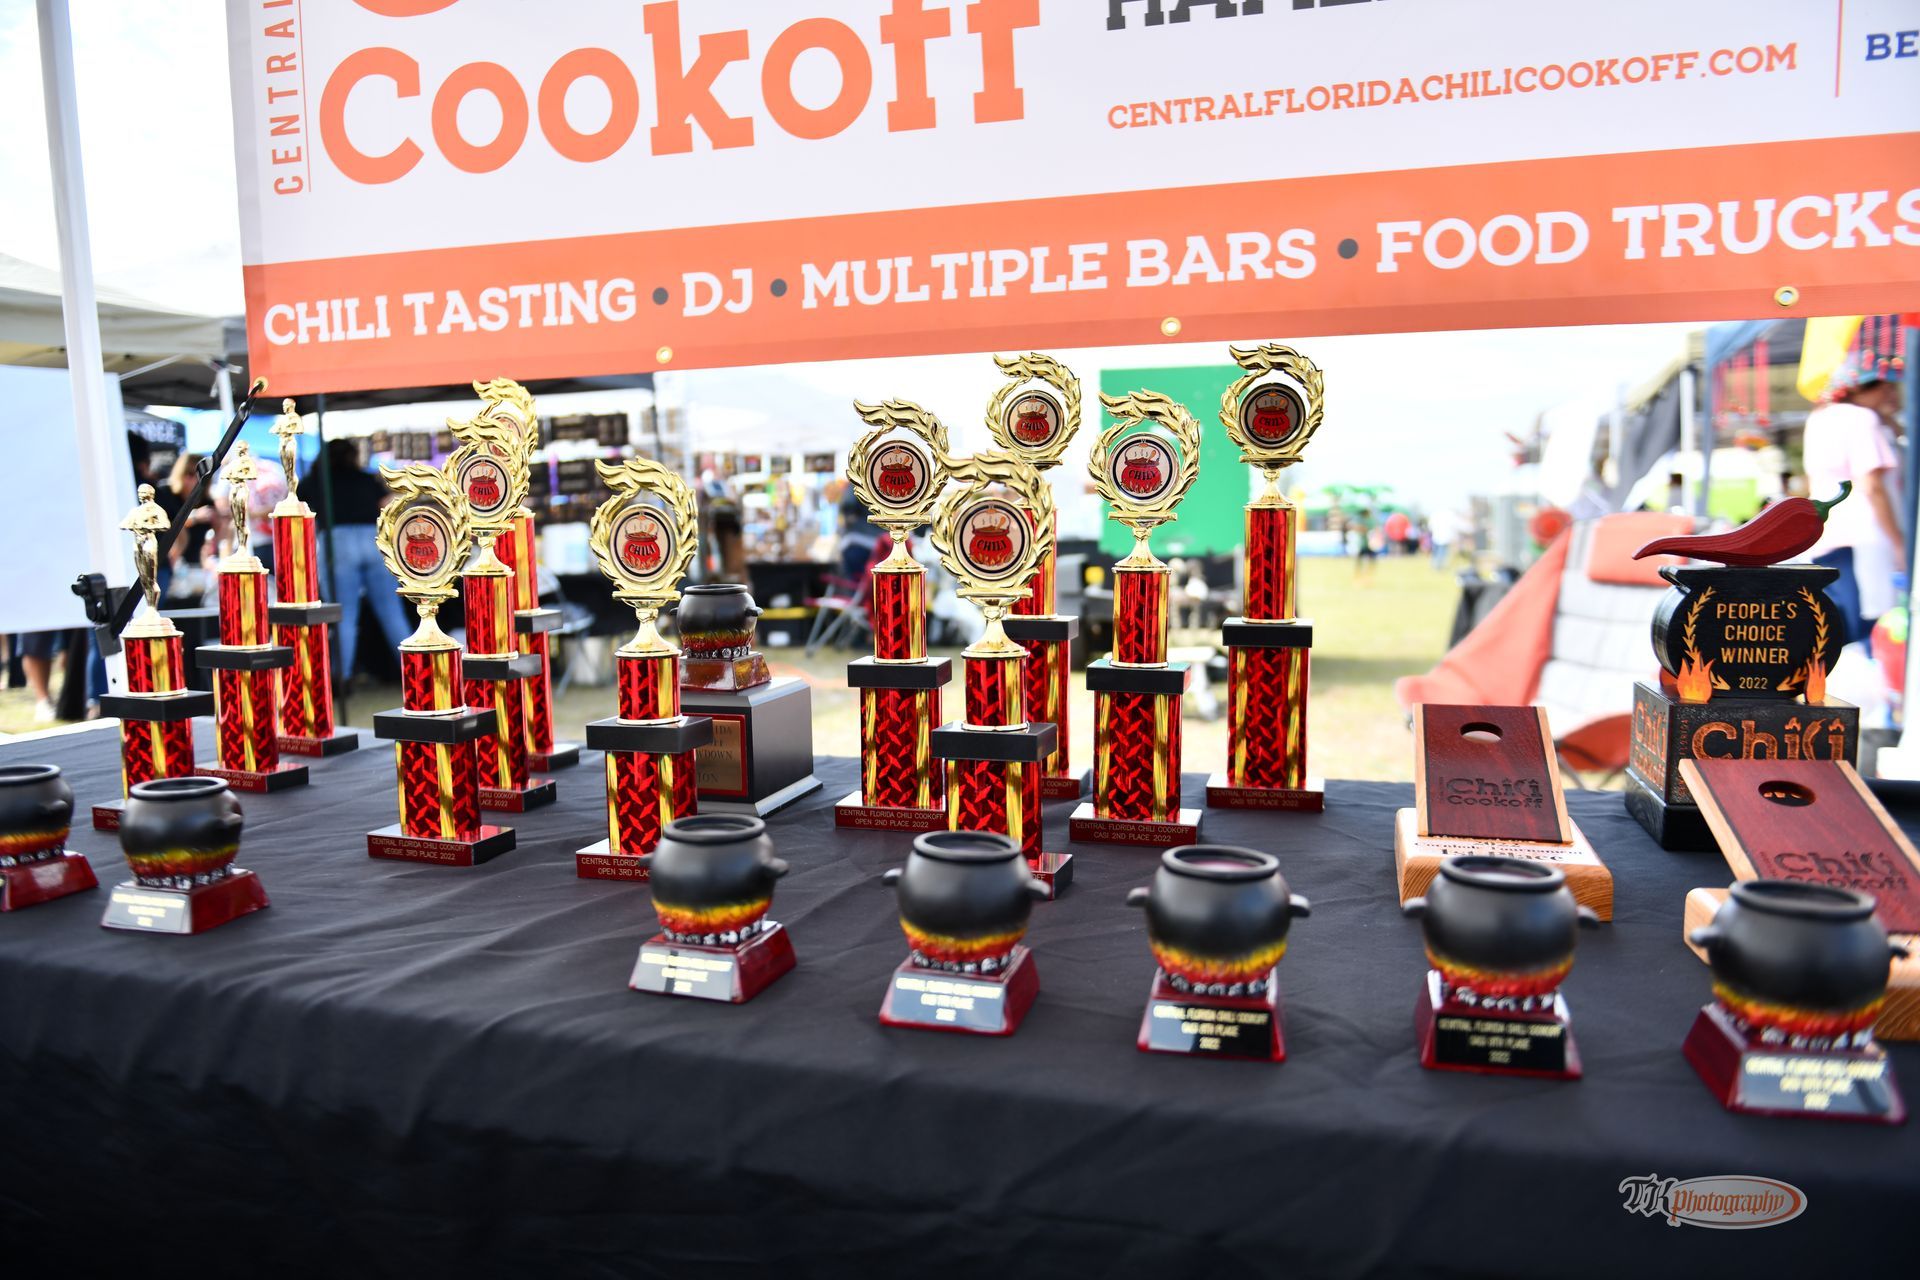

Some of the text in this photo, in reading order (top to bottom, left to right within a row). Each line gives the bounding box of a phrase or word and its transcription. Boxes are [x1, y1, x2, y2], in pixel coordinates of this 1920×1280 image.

[1108, 43, 1797, 129] CENTRALFLORIDACHILICOOKOFF.COM
[319, 0, 1040, 185] Cookoff
[264, 188, 1920, 346] CHILI TASTING DJ MULTIPLE BARS FOOD TRUCKS
[885, 475, 910, 485] CHILI
[1128, 470, 1155, 480] CHILI
[629, 544, 656, 556] CHILI
[977, 539, 1007, 551] CHILI
[1716, 601, 1798, 620] PEOPLE'S
[1724, 625, 1786, 642] CHOICE
[1721, 647, 1789, 664] WINNER
[1738, 677, 1769, 689] 2022
[1448, 795, 1543, 808] Cookoff
[1157, 826, 1190, 834] COOKOFF
[372, 838, 396, 846] CENTRAL
[440, 844, 465, 852] COOKOFF
[581, 857, 611, 866] CENTRAL
[635, 869, 649, 877] PLAC
